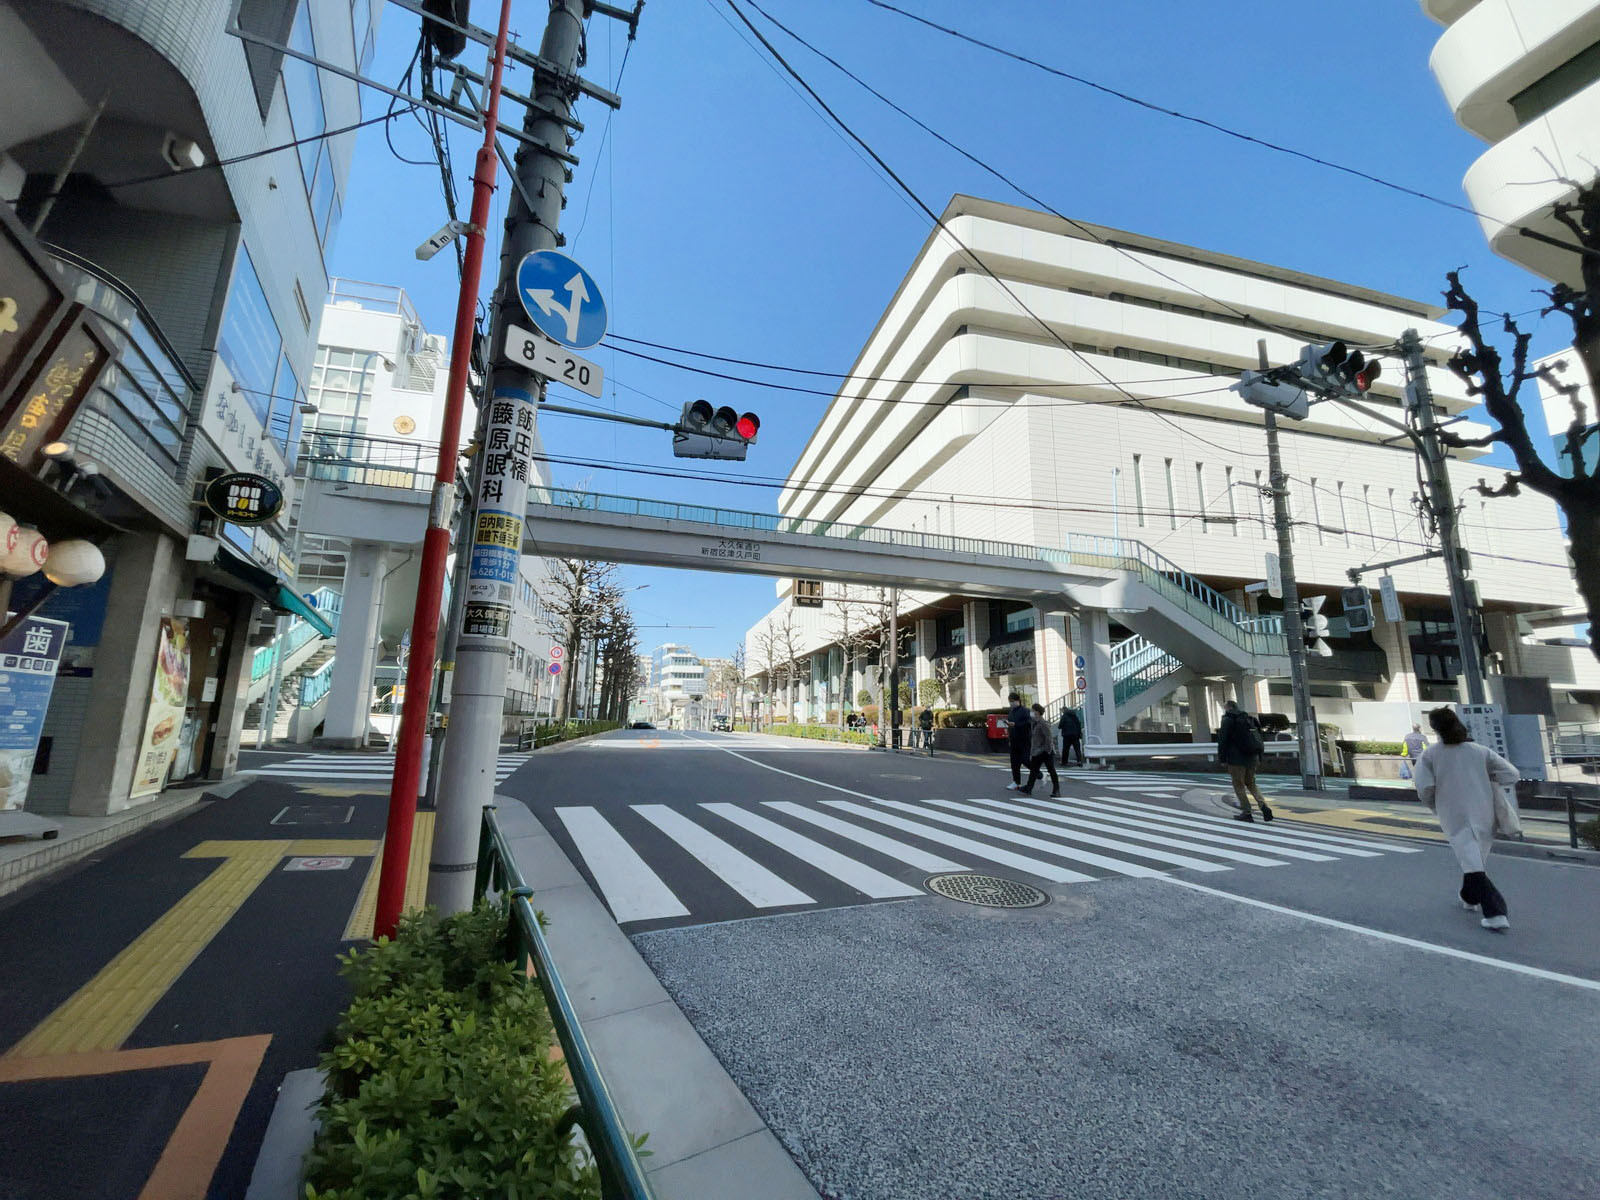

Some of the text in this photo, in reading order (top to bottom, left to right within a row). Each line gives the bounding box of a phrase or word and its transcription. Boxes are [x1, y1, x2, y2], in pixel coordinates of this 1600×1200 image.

[522, 339, 590, 386] 8-20
[481, 402, 515, 503] 藤原眼科
[510, 407, 534, 484] 飯田橋
[701, 547, 760, 561] 新宿区津久戸町
[718, 540, 760, 552] 大久保通り
[467, 608, 510, 621] 大久保通り
[22, 626, 53, 656] 歯
